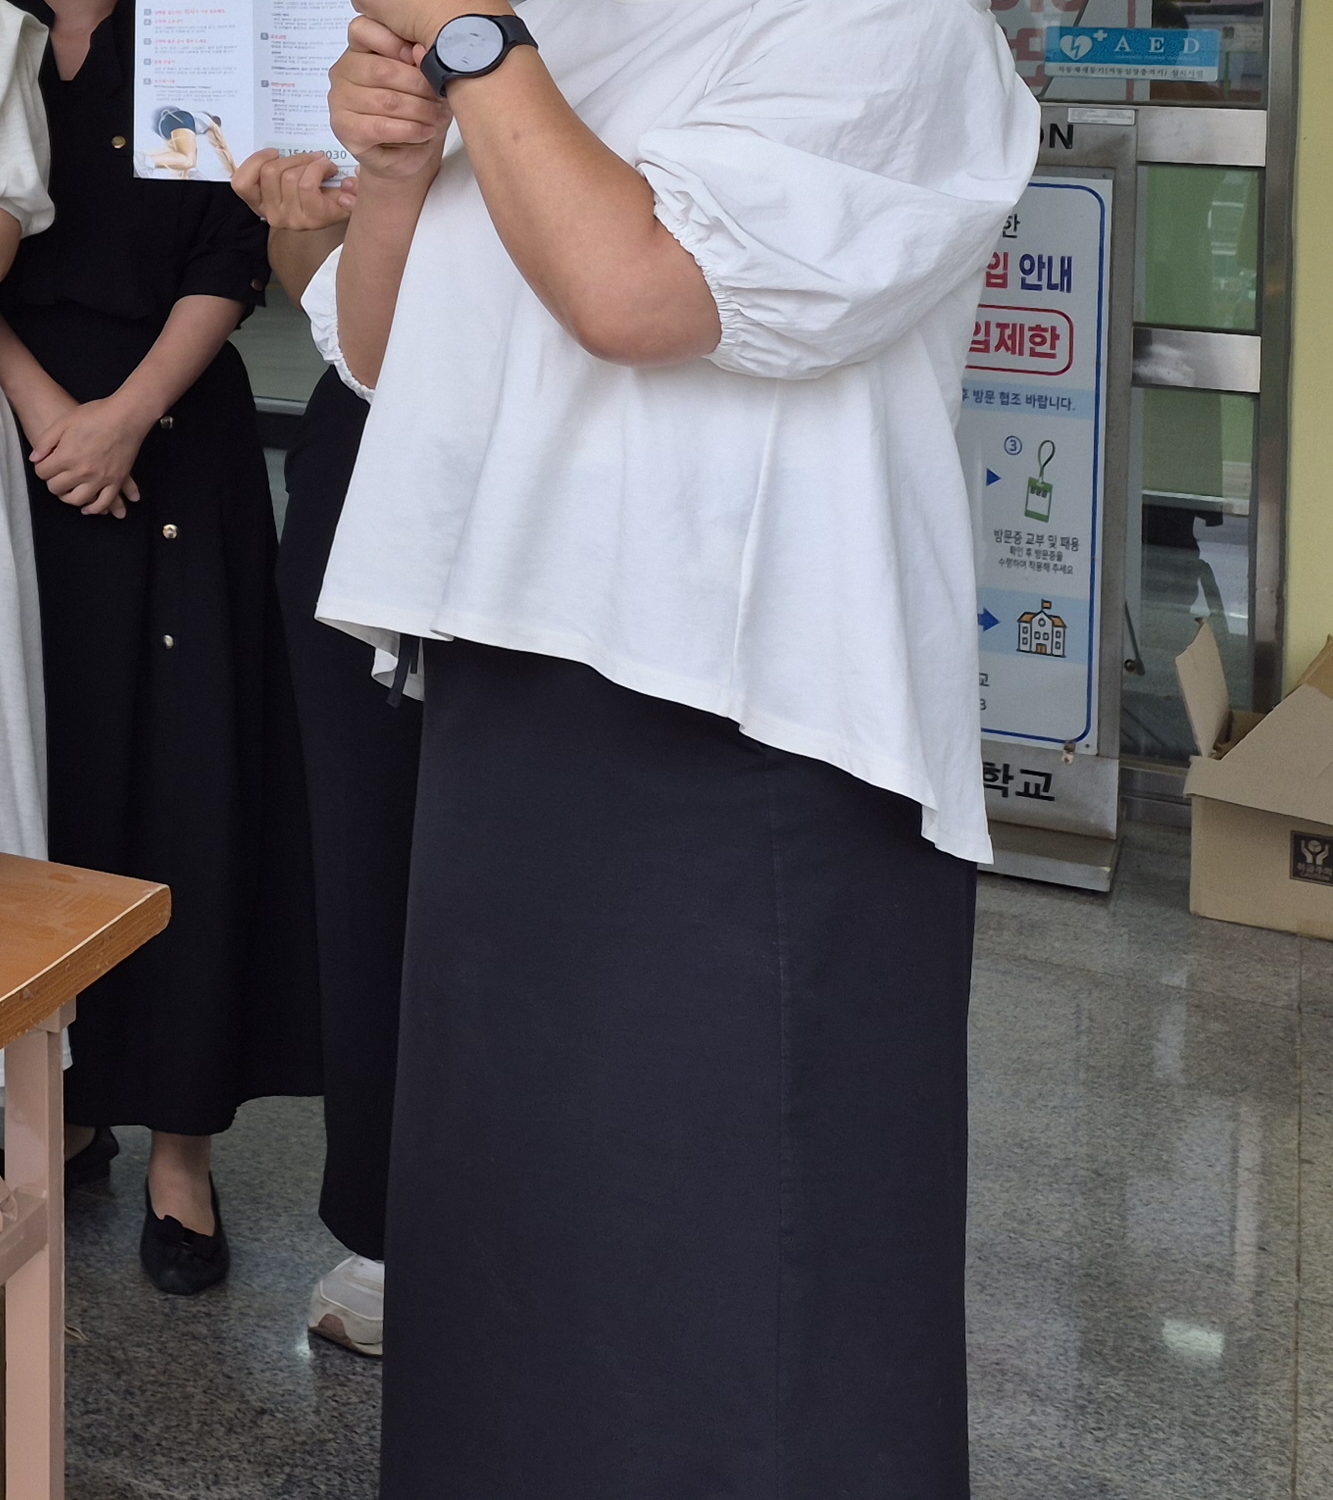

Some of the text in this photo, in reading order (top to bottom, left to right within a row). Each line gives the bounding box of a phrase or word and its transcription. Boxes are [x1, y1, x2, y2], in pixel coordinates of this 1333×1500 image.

[1019, 253, 1072, 293] 안내
[973, 389, 995, 404] 방문
[999, 391, 1021, 406] 협조
[1025, 393, 1076, 411] 바랍니다.
[993, 529, 1022, 545] 방문증
[1025, 532, 1045, 546] 교부
